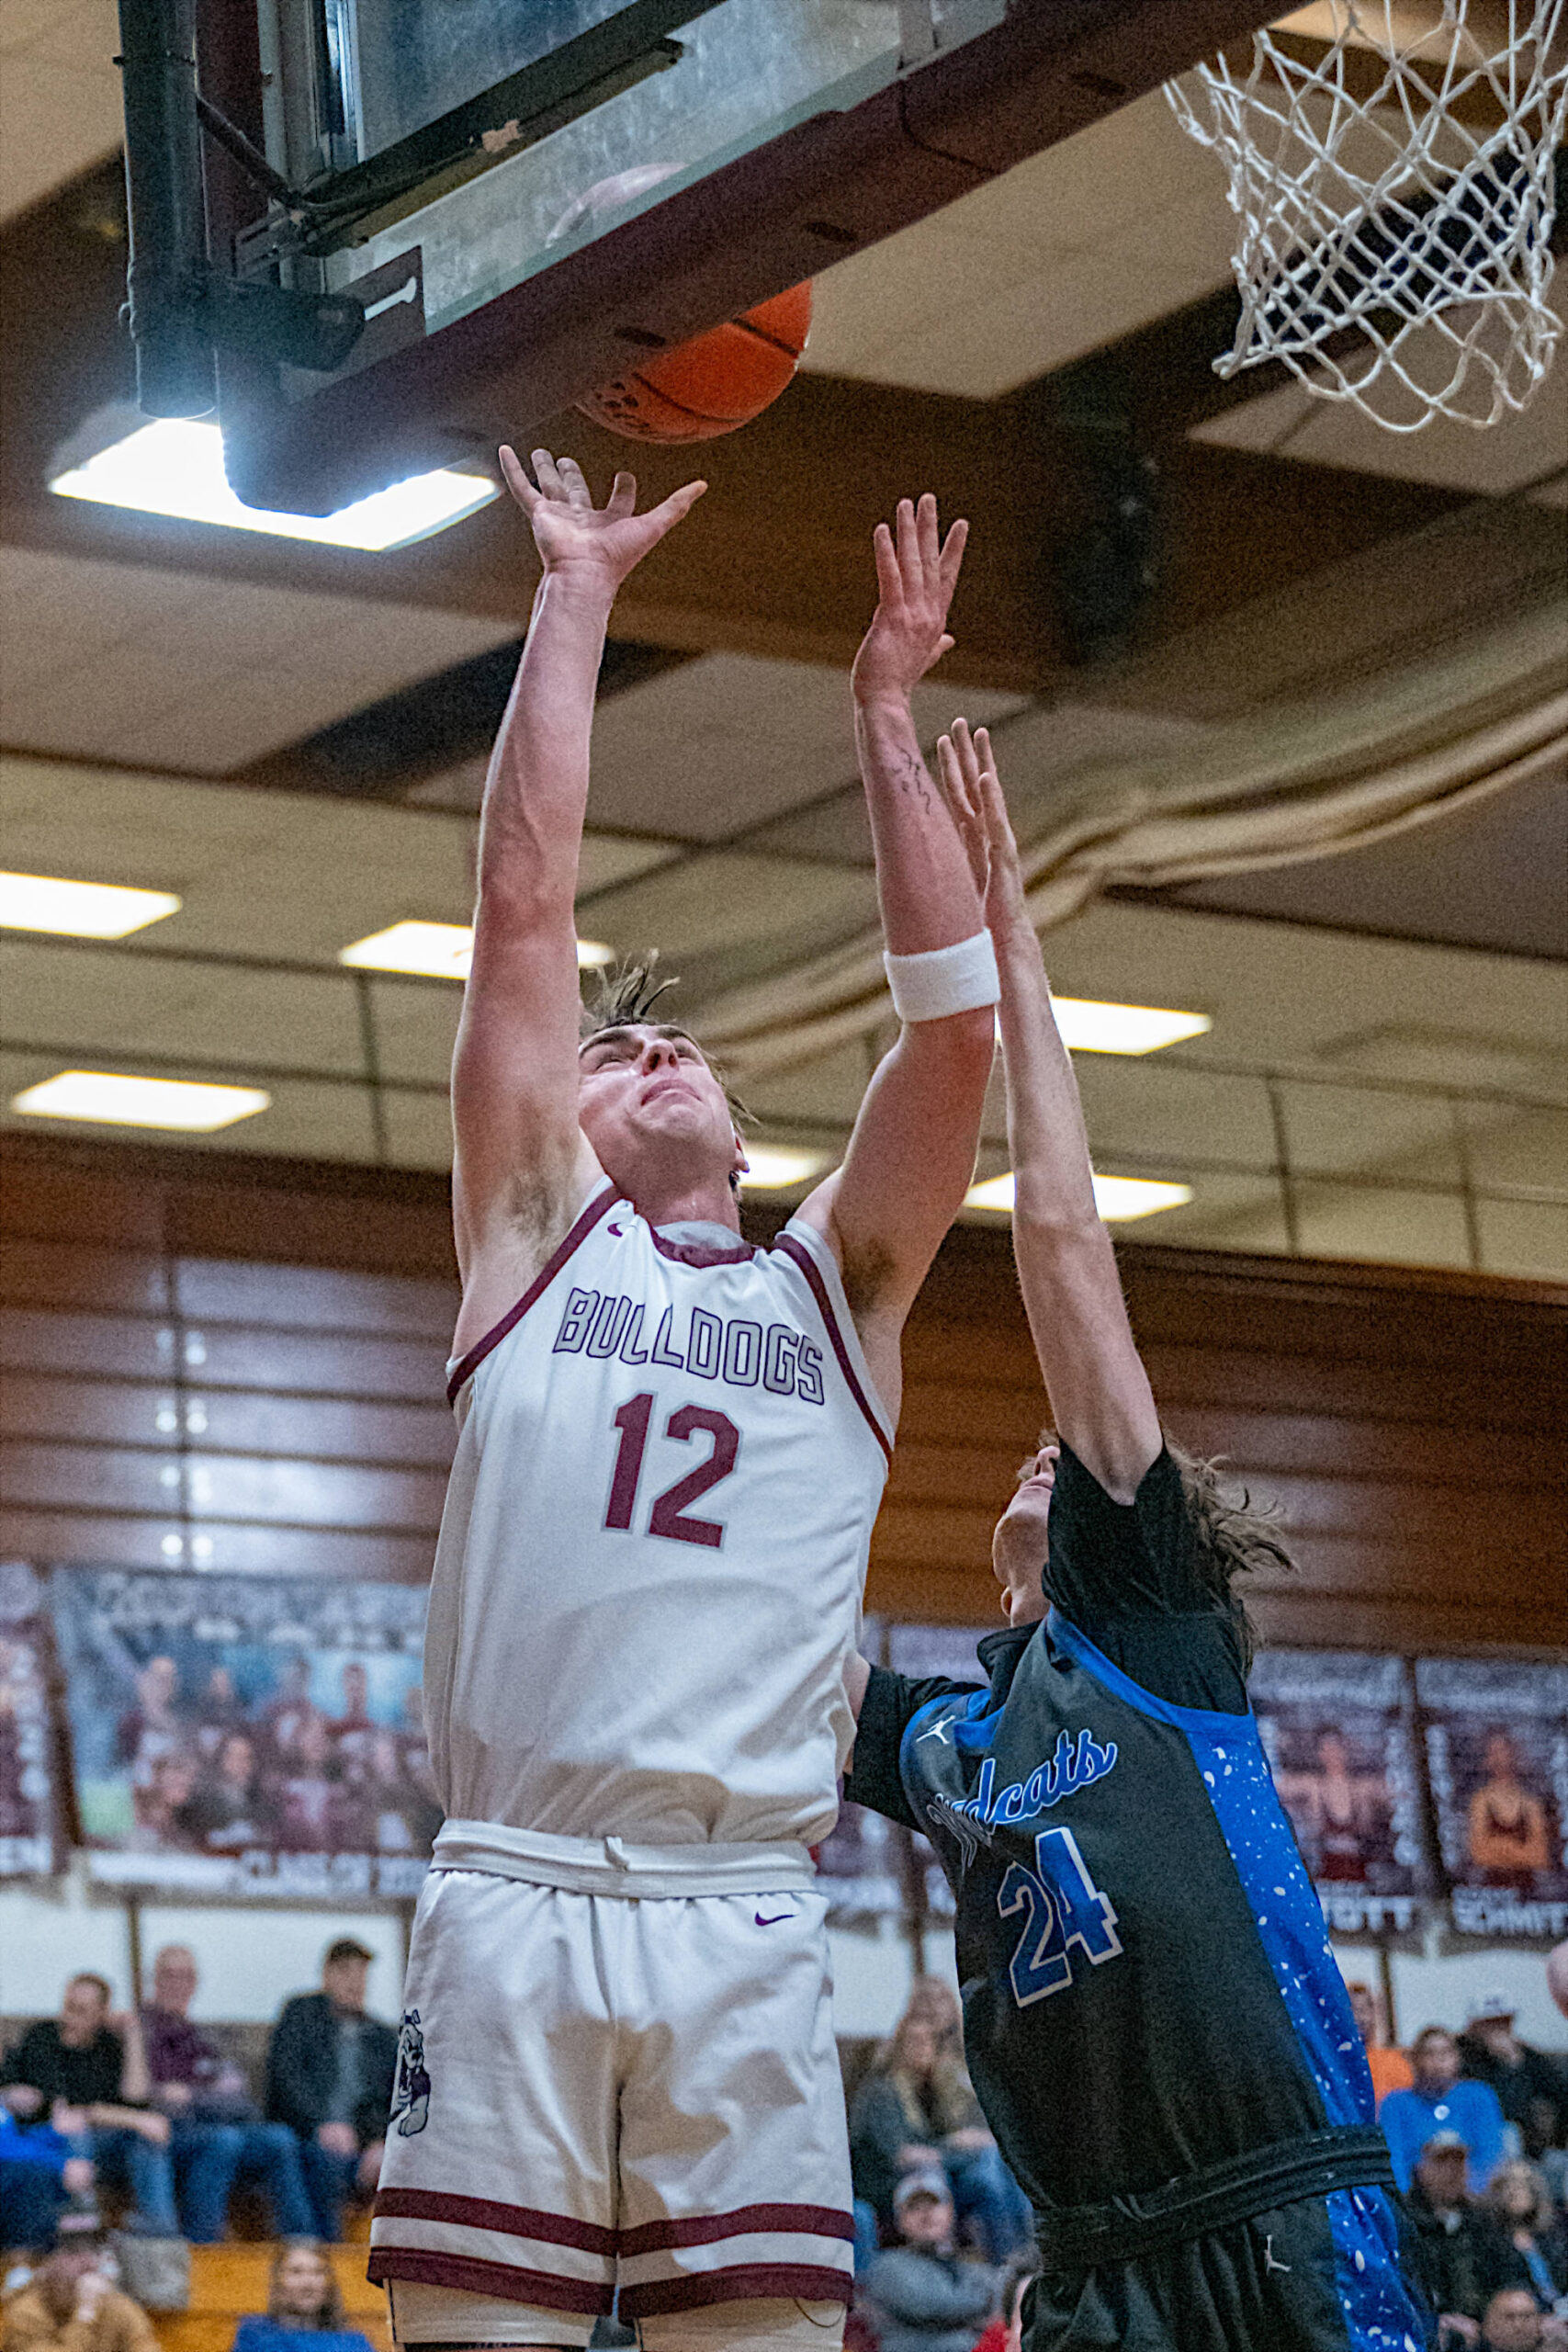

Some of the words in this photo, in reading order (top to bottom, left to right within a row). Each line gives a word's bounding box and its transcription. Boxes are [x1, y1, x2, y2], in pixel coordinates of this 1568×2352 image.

[552, 1286, 825, 1405] BULLDOGS
[602, 1390, 743, 1552] 12
[997, 1826, 1123, 2007] 24
